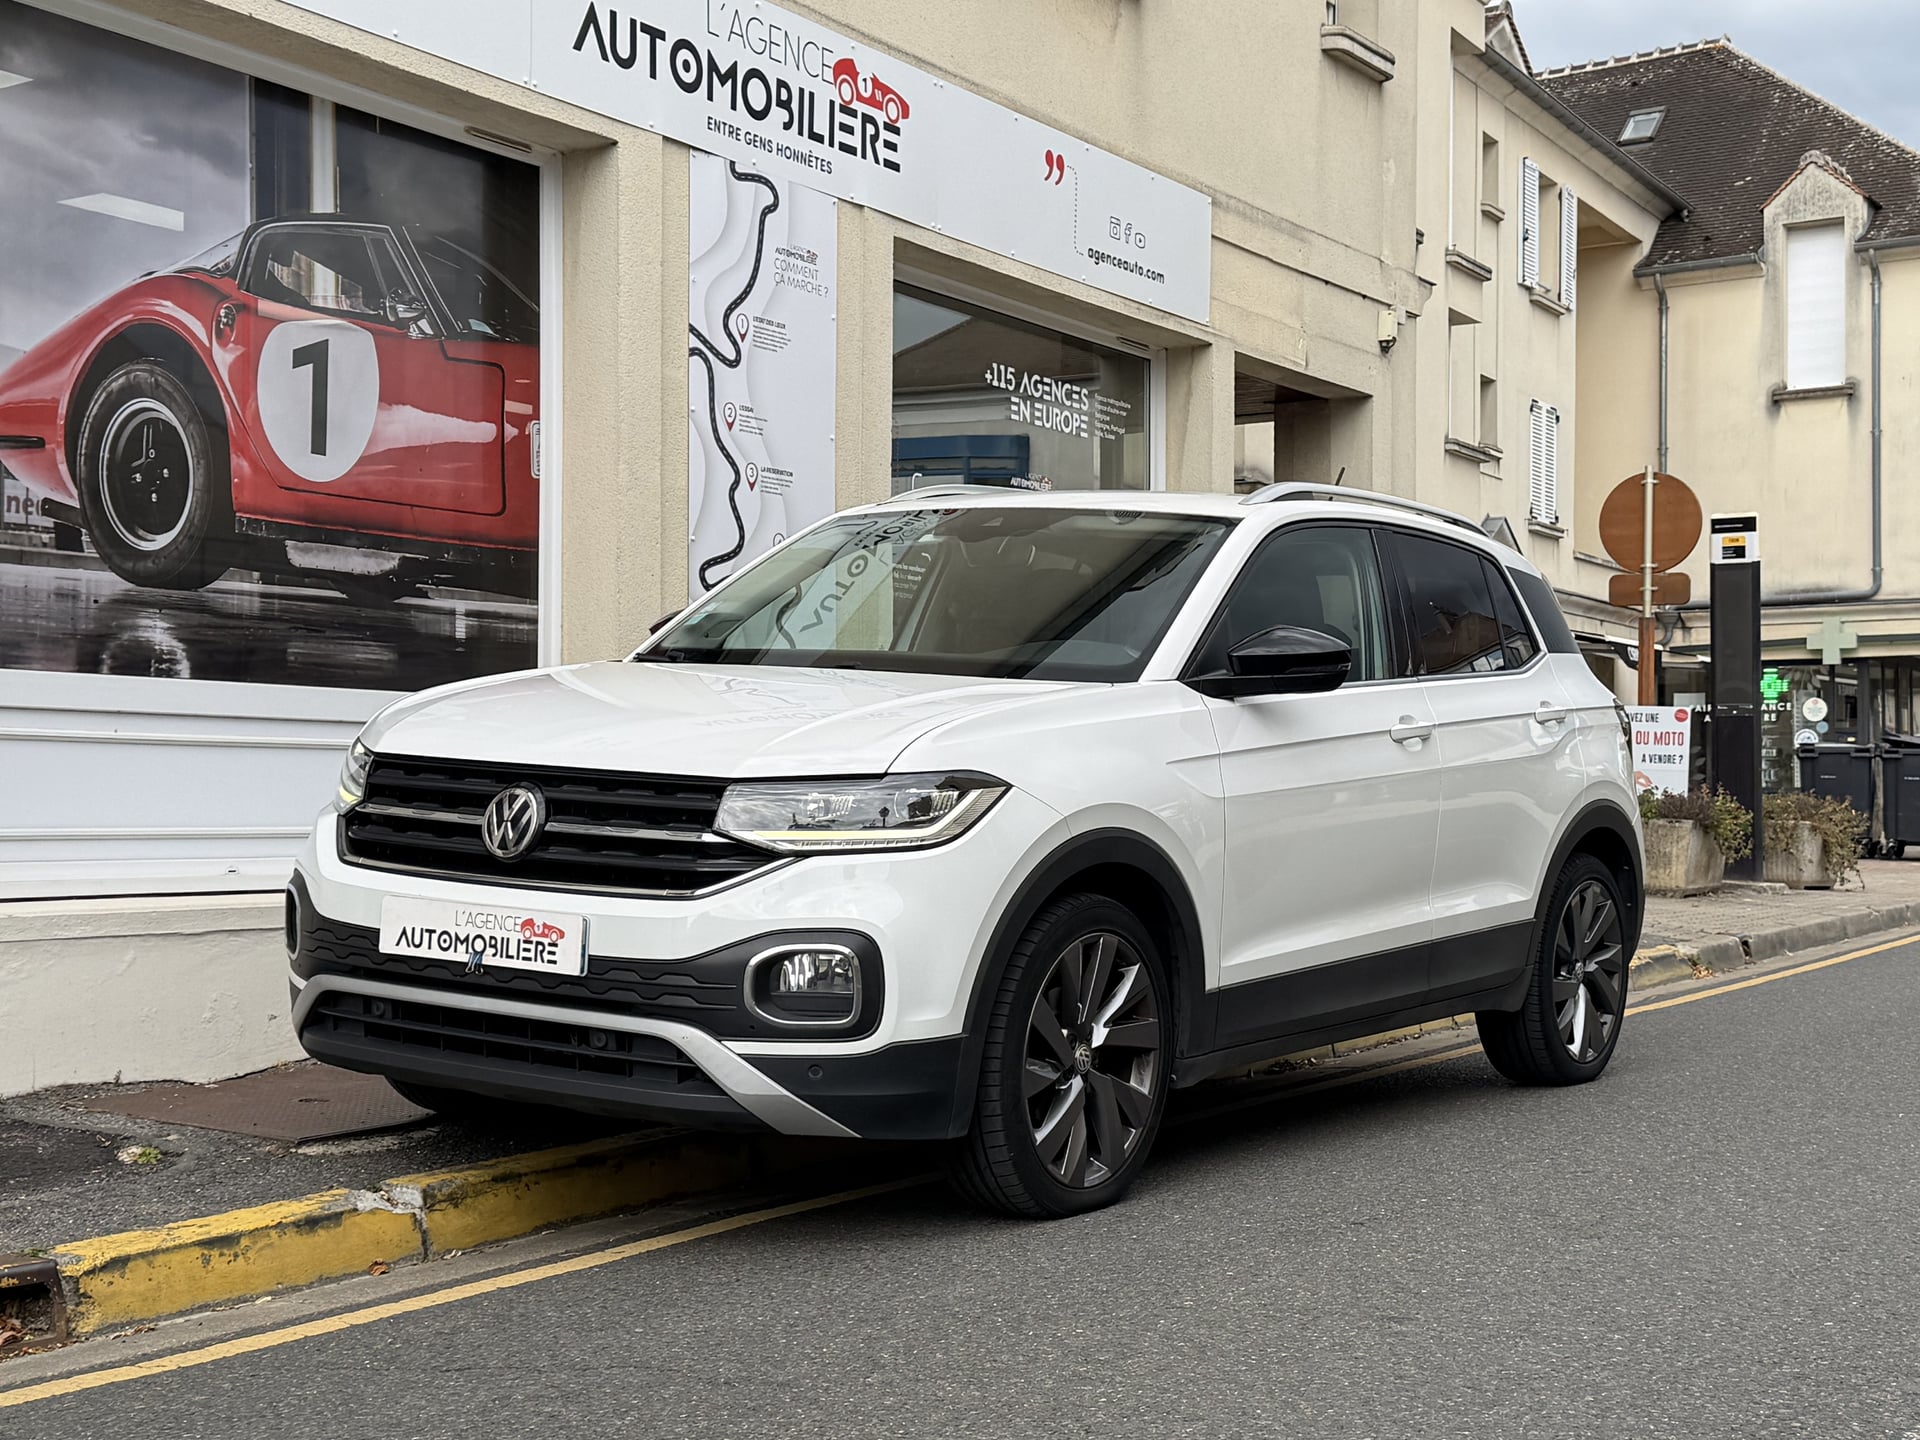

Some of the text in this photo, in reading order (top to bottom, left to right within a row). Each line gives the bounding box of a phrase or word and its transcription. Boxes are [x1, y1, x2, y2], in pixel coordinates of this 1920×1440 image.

[707, 0, 834, 86] L'AGENCE
[707, 115, 833, 175] ENTRE GENS HONNÊTES
[774, 257, 819, 281] COMMENT
[1087, 247, 1165, 285] agenceauto.com
[774, 271, 786, 287] ÇA
[787, 276, 823, 297] MARCHE
[292, 338, 329, 457] 1
[985, 362, 1089, 411] +115 AGENCES
[727, 407, 733, 418] 2
[1010, 396, 1089, 438] EN EUROPE
[749, 467, 755, 478] 3
[1645, 712, 1660, 723] UNE
[1636, 730, 1684, 746] OU MOTO
[1649, 754, 1677, 764] VENDRE
[455, 910, 522, 933] L'AGENCE
